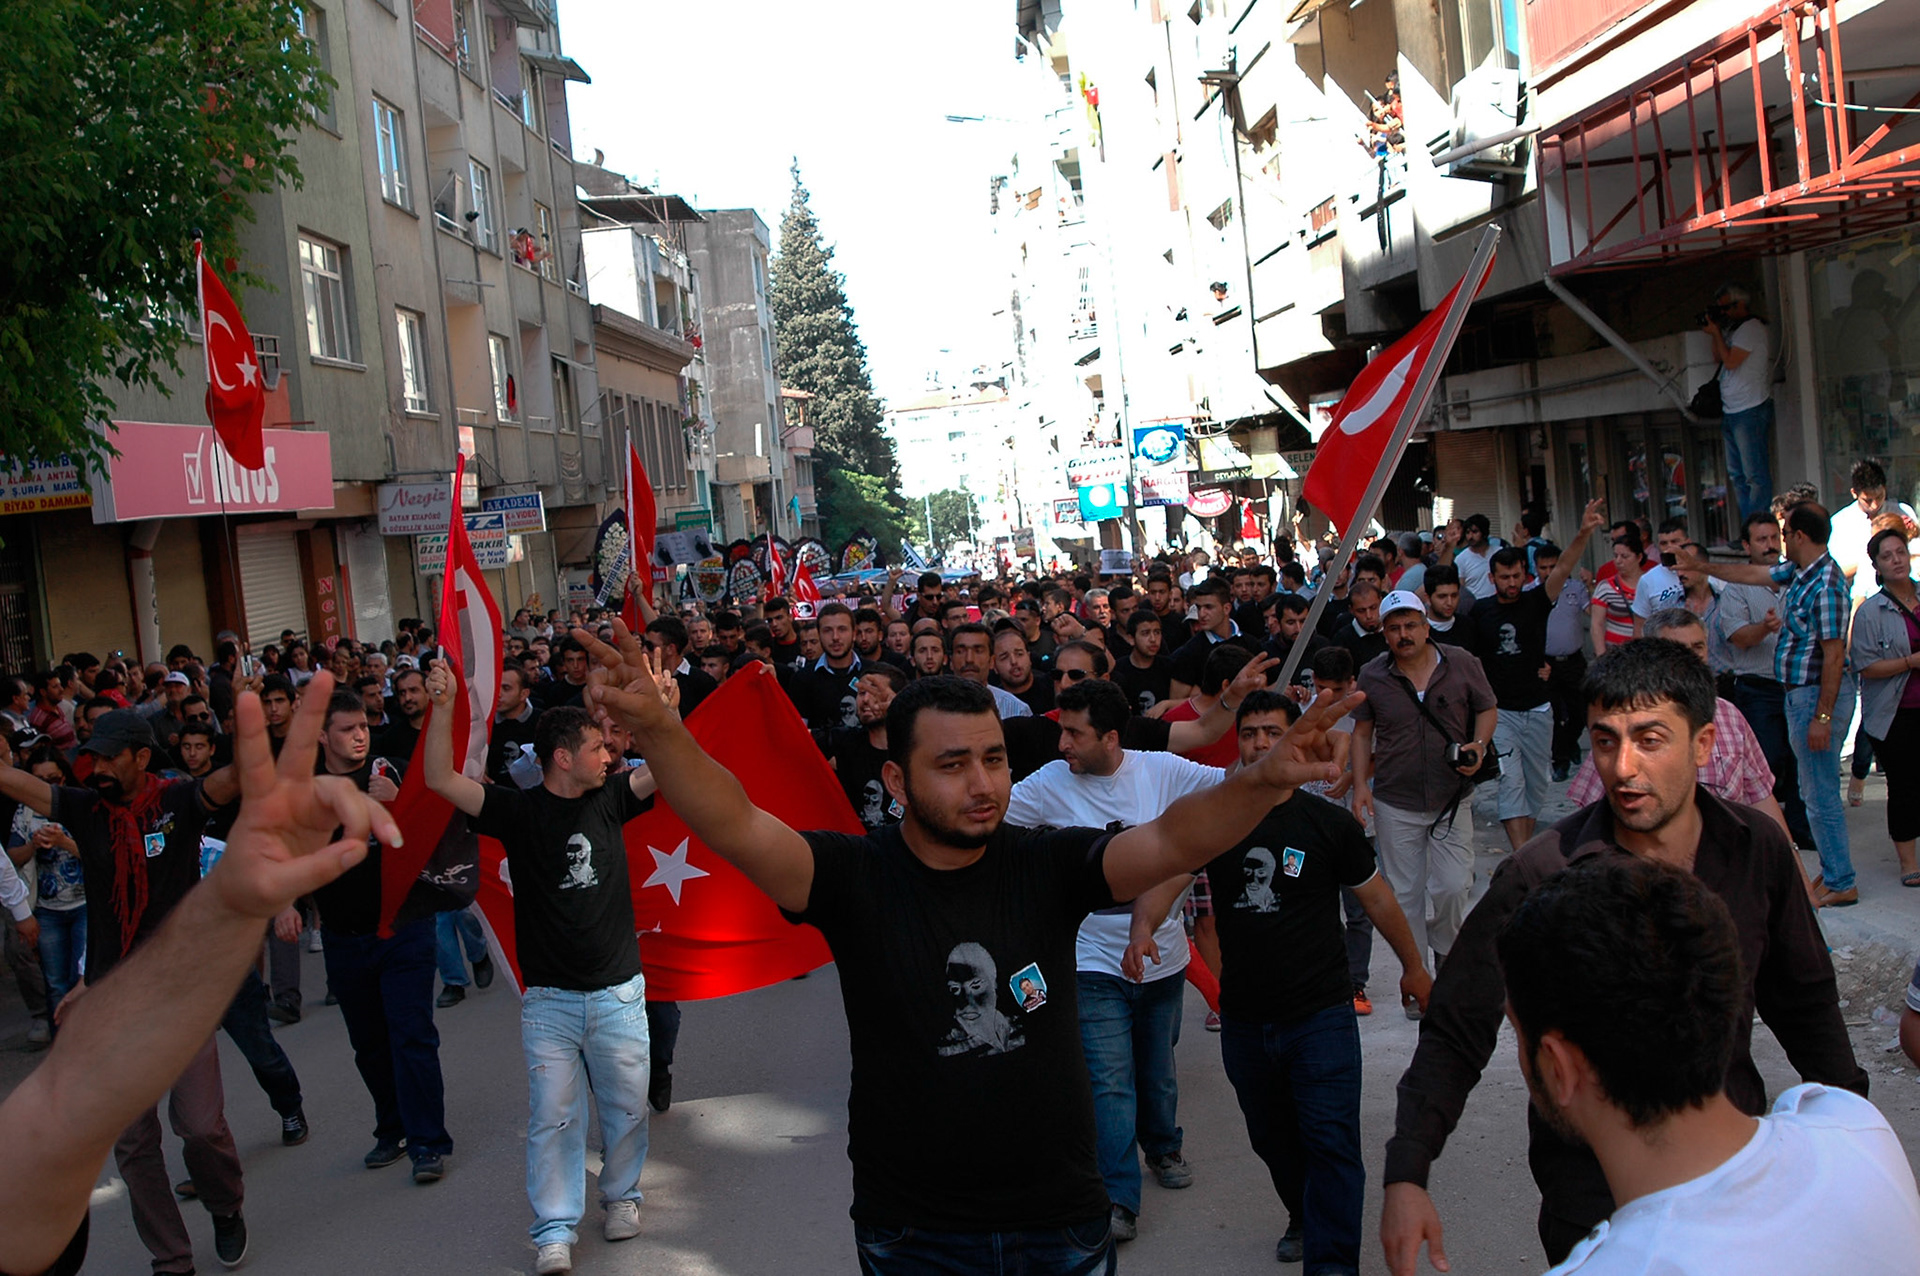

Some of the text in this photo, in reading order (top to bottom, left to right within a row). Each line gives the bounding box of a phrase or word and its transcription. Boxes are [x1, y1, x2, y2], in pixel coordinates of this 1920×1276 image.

[47, 470, 78, 481] ANTAL
[53, 481, 80, 492] MARD
[40, 494, 90, 509] DAMMAM
